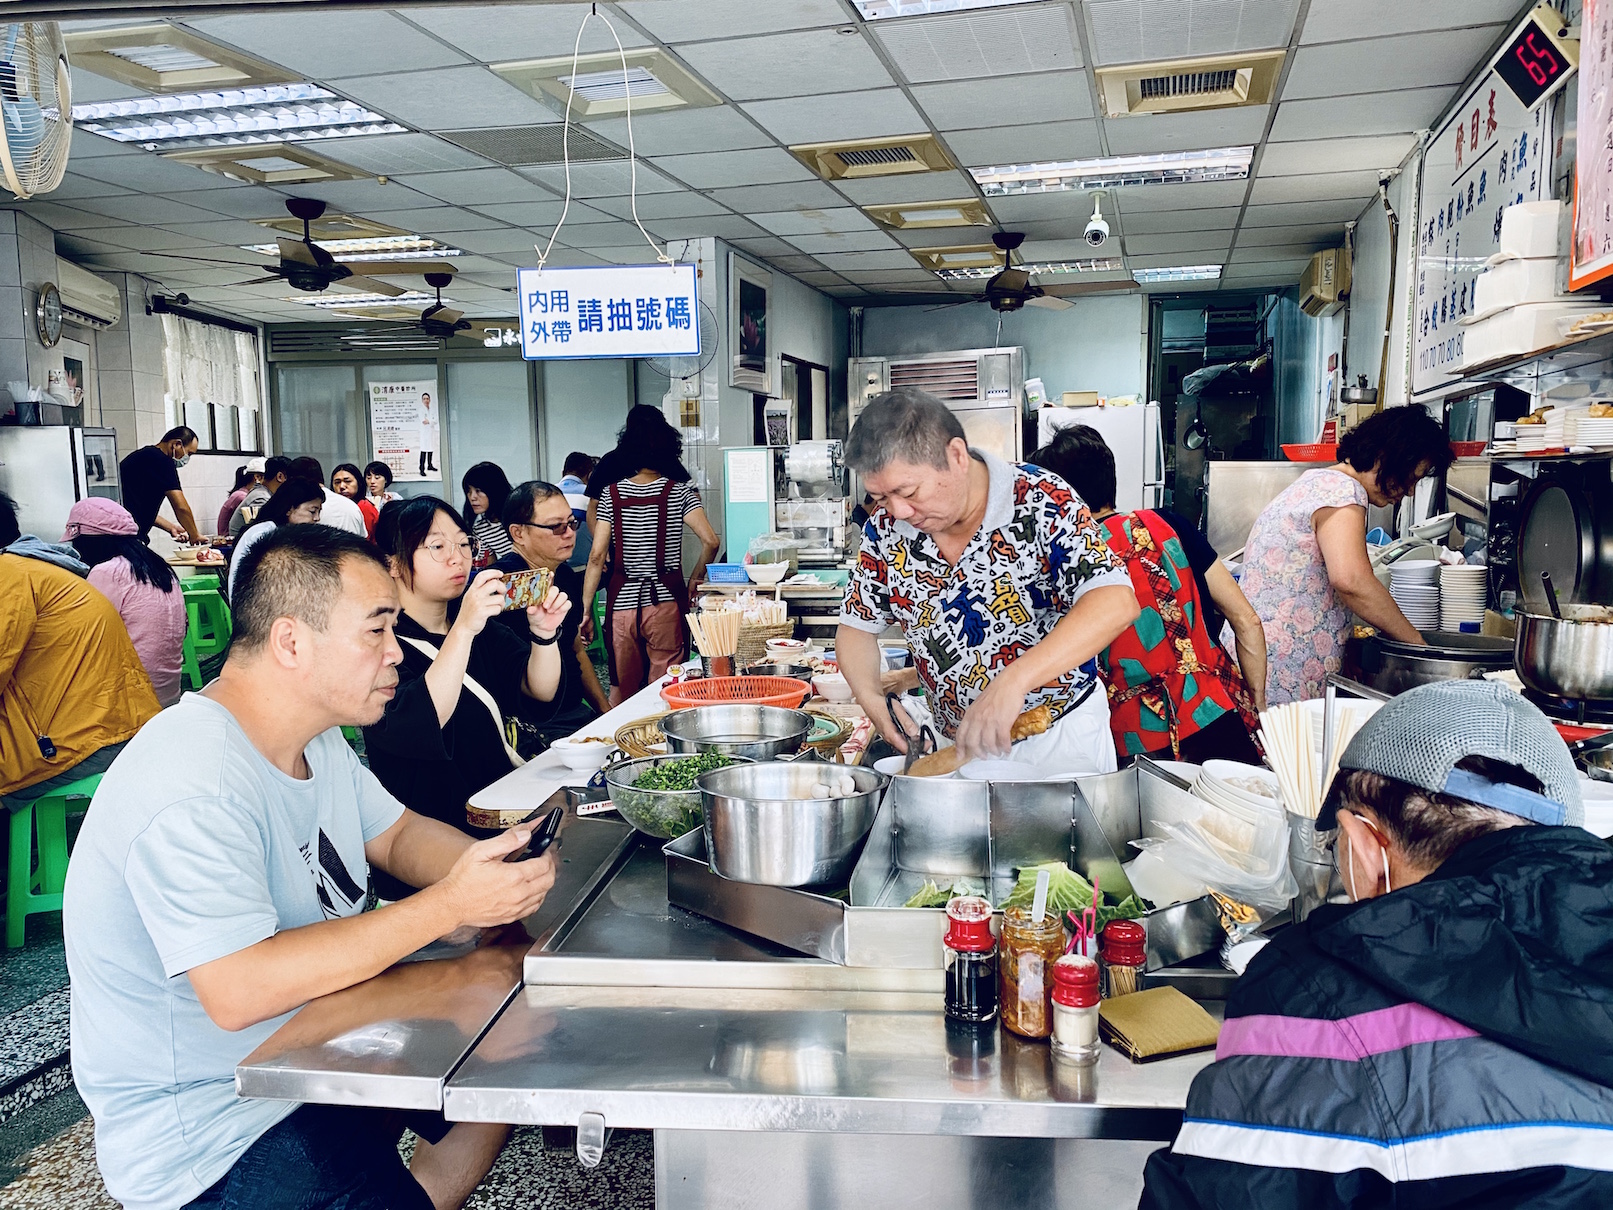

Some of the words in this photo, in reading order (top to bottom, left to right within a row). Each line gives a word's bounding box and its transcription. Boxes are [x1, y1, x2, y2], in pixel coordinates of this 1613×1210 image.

[1516, 32, 1558, 86] 65
[1455, 88, 1498, 171] 價目表
[528, 290, 570, 314] 內用
[577, 296, 691, 333] 請抽號碼
[530, 320, 572, 344] 外帶
[1437, 341, 1446, 365] 70
[1446, 337, 1456, 362] 80
